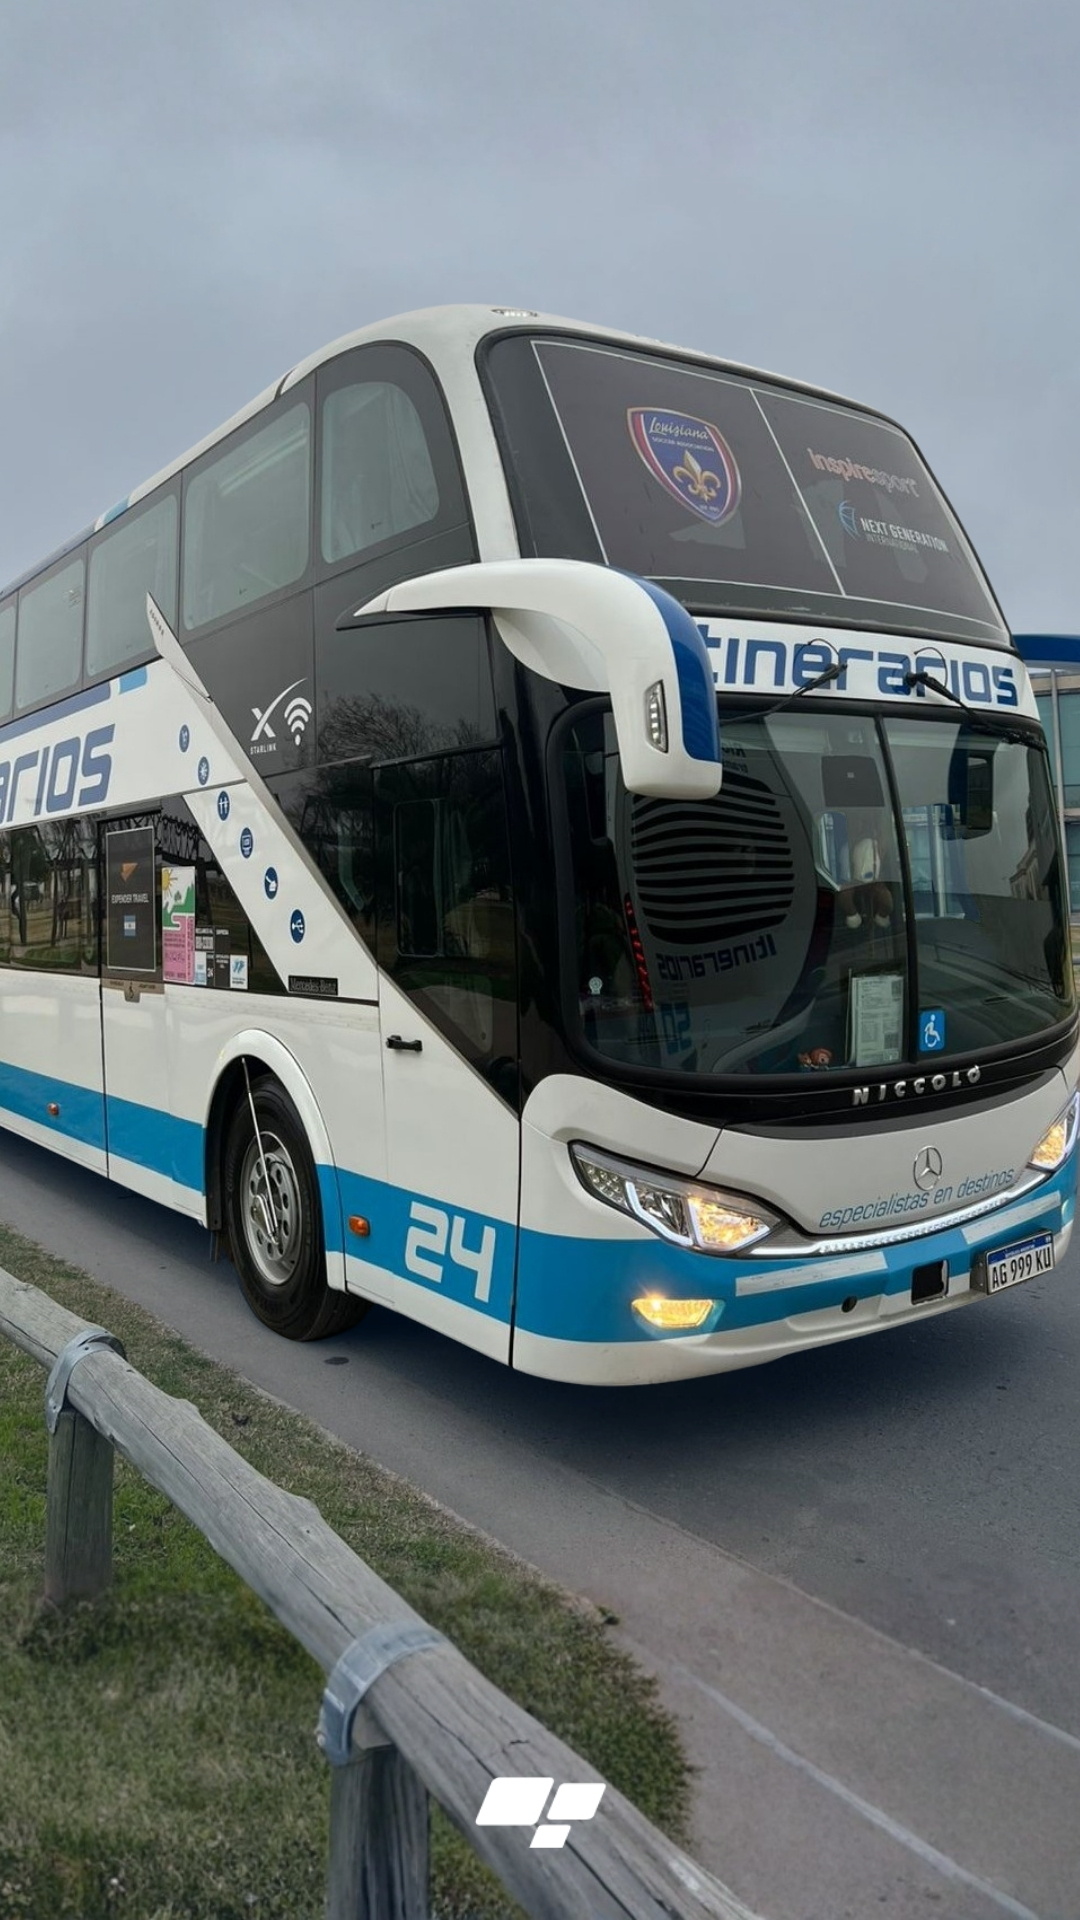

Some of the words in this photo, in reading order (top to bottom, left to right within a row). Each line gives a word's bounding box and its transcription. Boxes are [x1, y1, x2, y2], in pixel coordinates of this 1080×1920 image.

[648, 417, 709, 440] Louisiana
[806, 447, 919, 498] inspiresport
[860, 517, 889, 536] NEXT
[889, 523, 949, 552] GENERATION
[250, 743, 276, 755] STARLINK
[819, 1191, 930, 1231] especialistas
[933, 1186, 952, 1206] en
[957, 1168, 1014, 1198] destinos
[405, 1201, 496, 1303] 24
[993, 1263, 1007, 1289] AG
[1010, 1253, 1032, 1281] 999
[1035, 1246, 1051, 1272] KU
